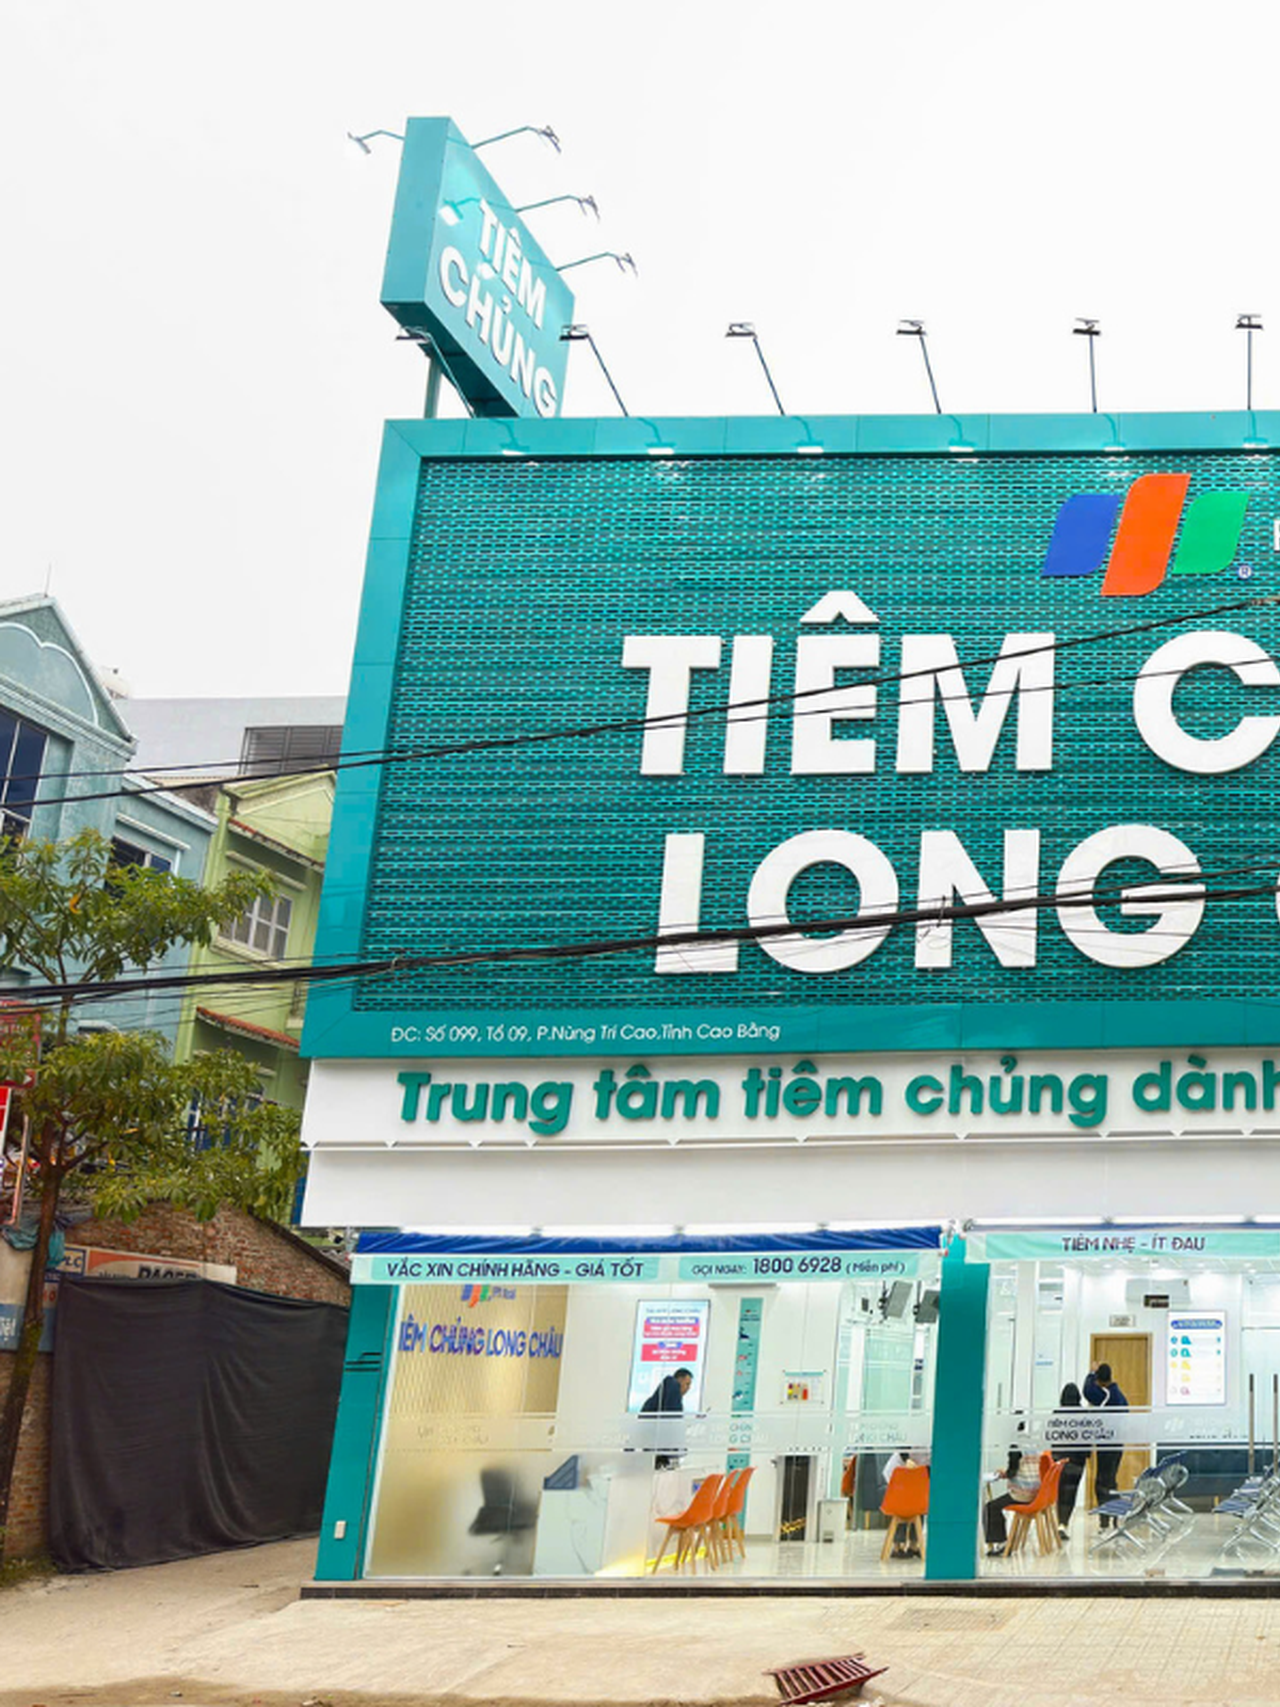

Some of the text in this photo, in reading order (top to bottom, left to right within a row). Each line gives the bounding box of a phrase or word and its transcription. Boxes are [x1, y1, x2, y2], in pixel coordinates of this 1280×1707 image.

[479, 196, 546, 330] TIÊM
[438, 244, 556, 418] CHỦNG
[622, 590, 1056, 776] TIÊM
[654, 829, 1207, 974] LONG
[391, 1026, 421, 1042] ĐC:
[449, 1025, 483, 1043] 099,
[508, 1025, 532, 1042] 09,
[696, 1024, 733, 1039] Cao
[737, 1021, 781, 1041] Bằng
[397, 1071, 574, 1135] Trung
[594, 1064, 720, 1118] tâm
[742, 1060, 882, 1117] tiêm
[905, 1056, 1108, 1128] chủng
[387, 1257, 423, 1277] VẮC
[426, 1262, 453, 1277] XIN
[457, 1258, 509, 1276] CHÍNH
[575, 1257, 606, 1276] GIÁ
[610, 1256, 644, 1276] TỐT
[752, 1258, 794, 1274] 1800
[797, 1257, 842, 1273] 6928
[1062, 1233, 1099, 1251] TIÊM
[1171, 1236, 1205, 1251] ĐAU
[485, 1328, 527, 1358] LONG
[528, 1326, 564, 1359] CHÂU
